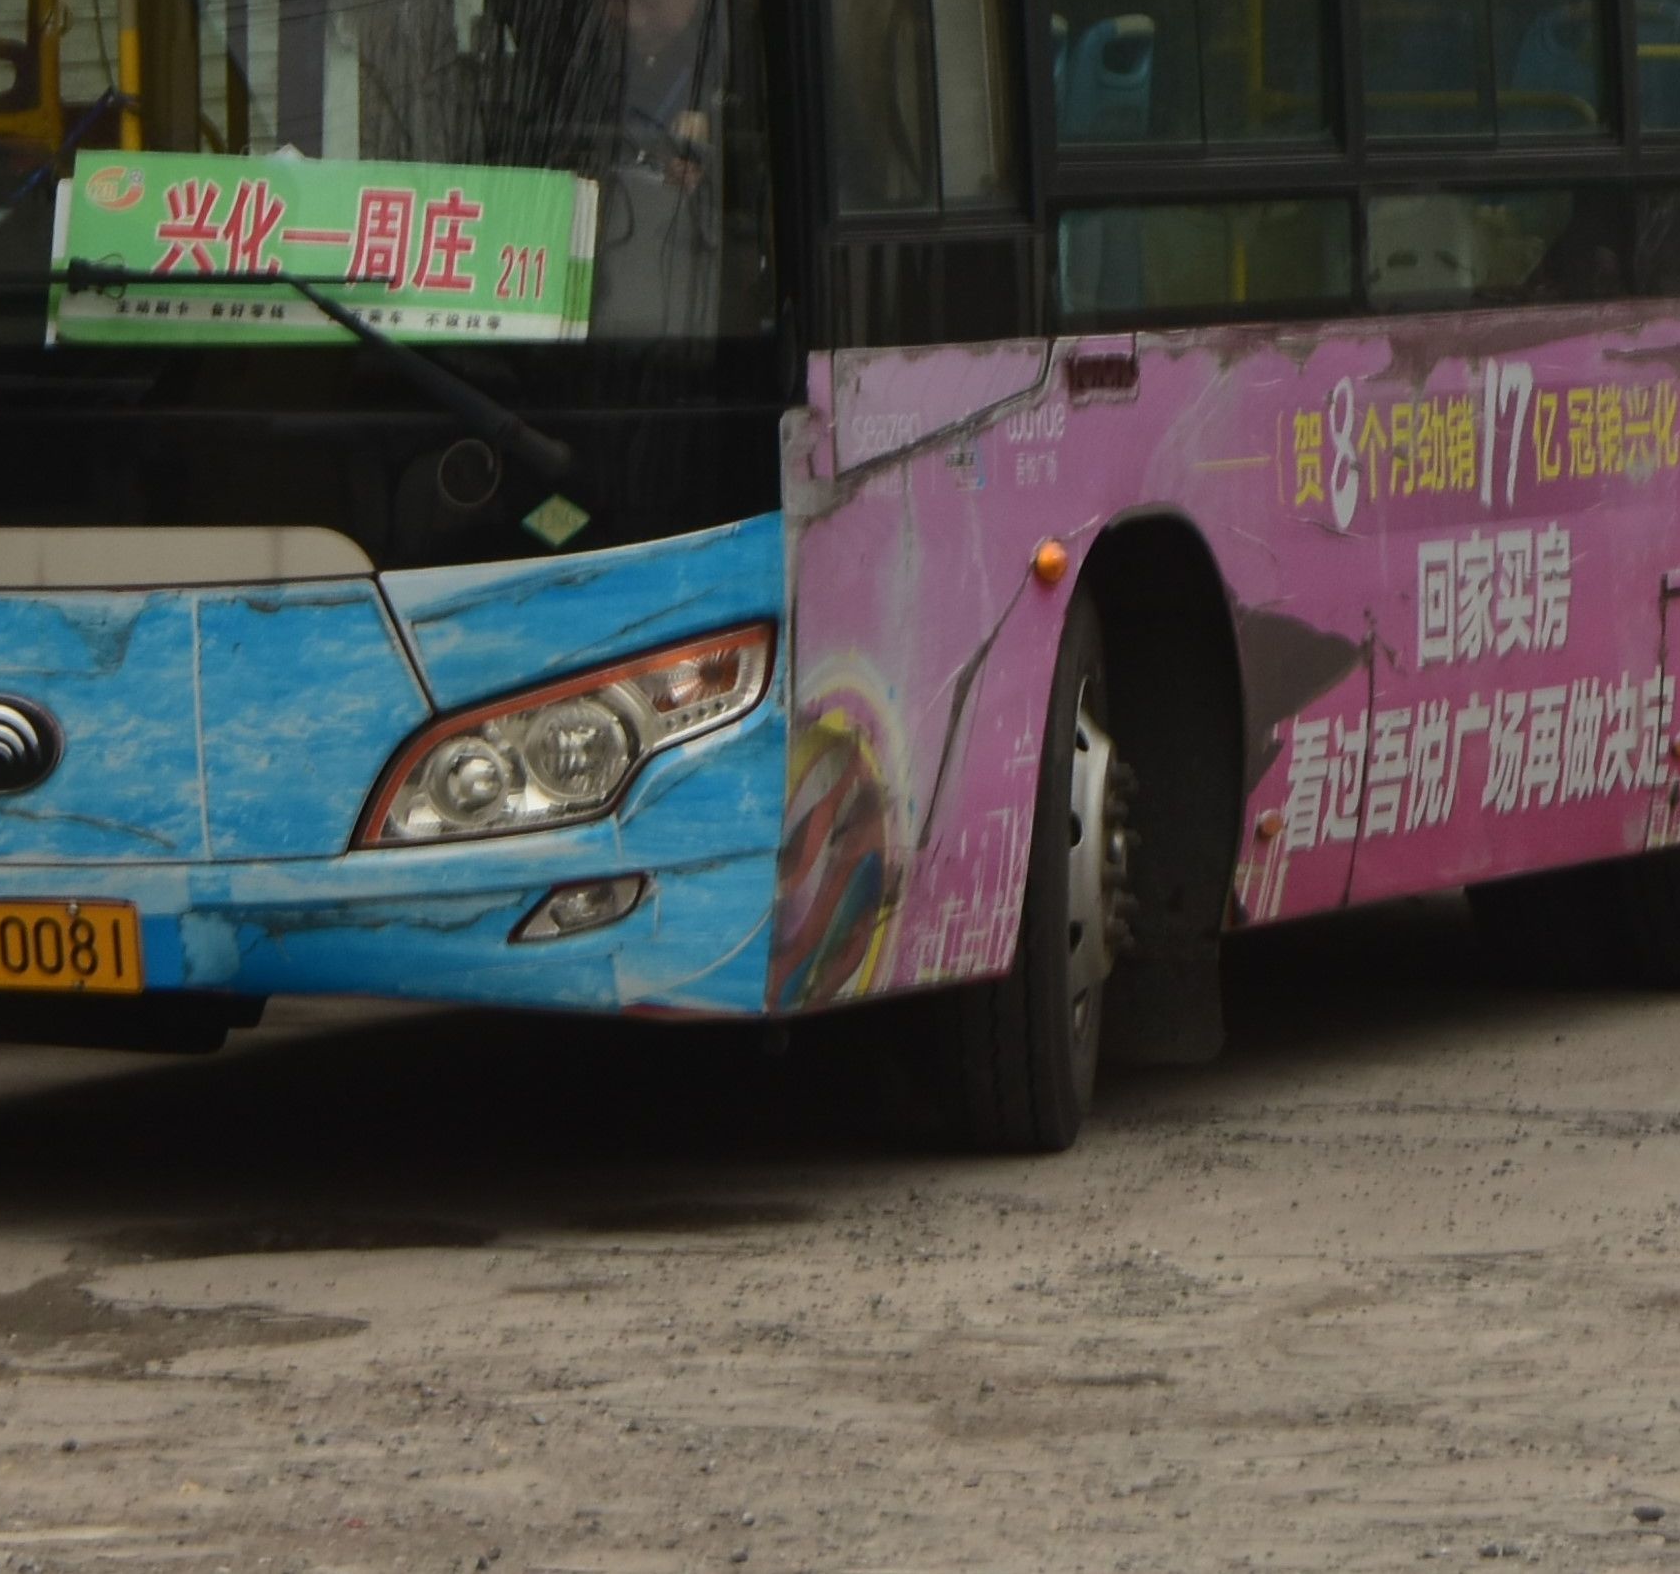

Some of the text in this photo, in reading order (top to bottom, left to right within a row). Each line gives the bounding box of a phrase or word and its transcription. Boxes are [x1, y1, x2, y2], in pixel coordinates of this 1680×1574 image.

[495, 245, 547, 300] 211
[1417, 521, 1573, 668] 回家买房
[1283, 664, 1676, 853] 看过吾悦广场再做决定
